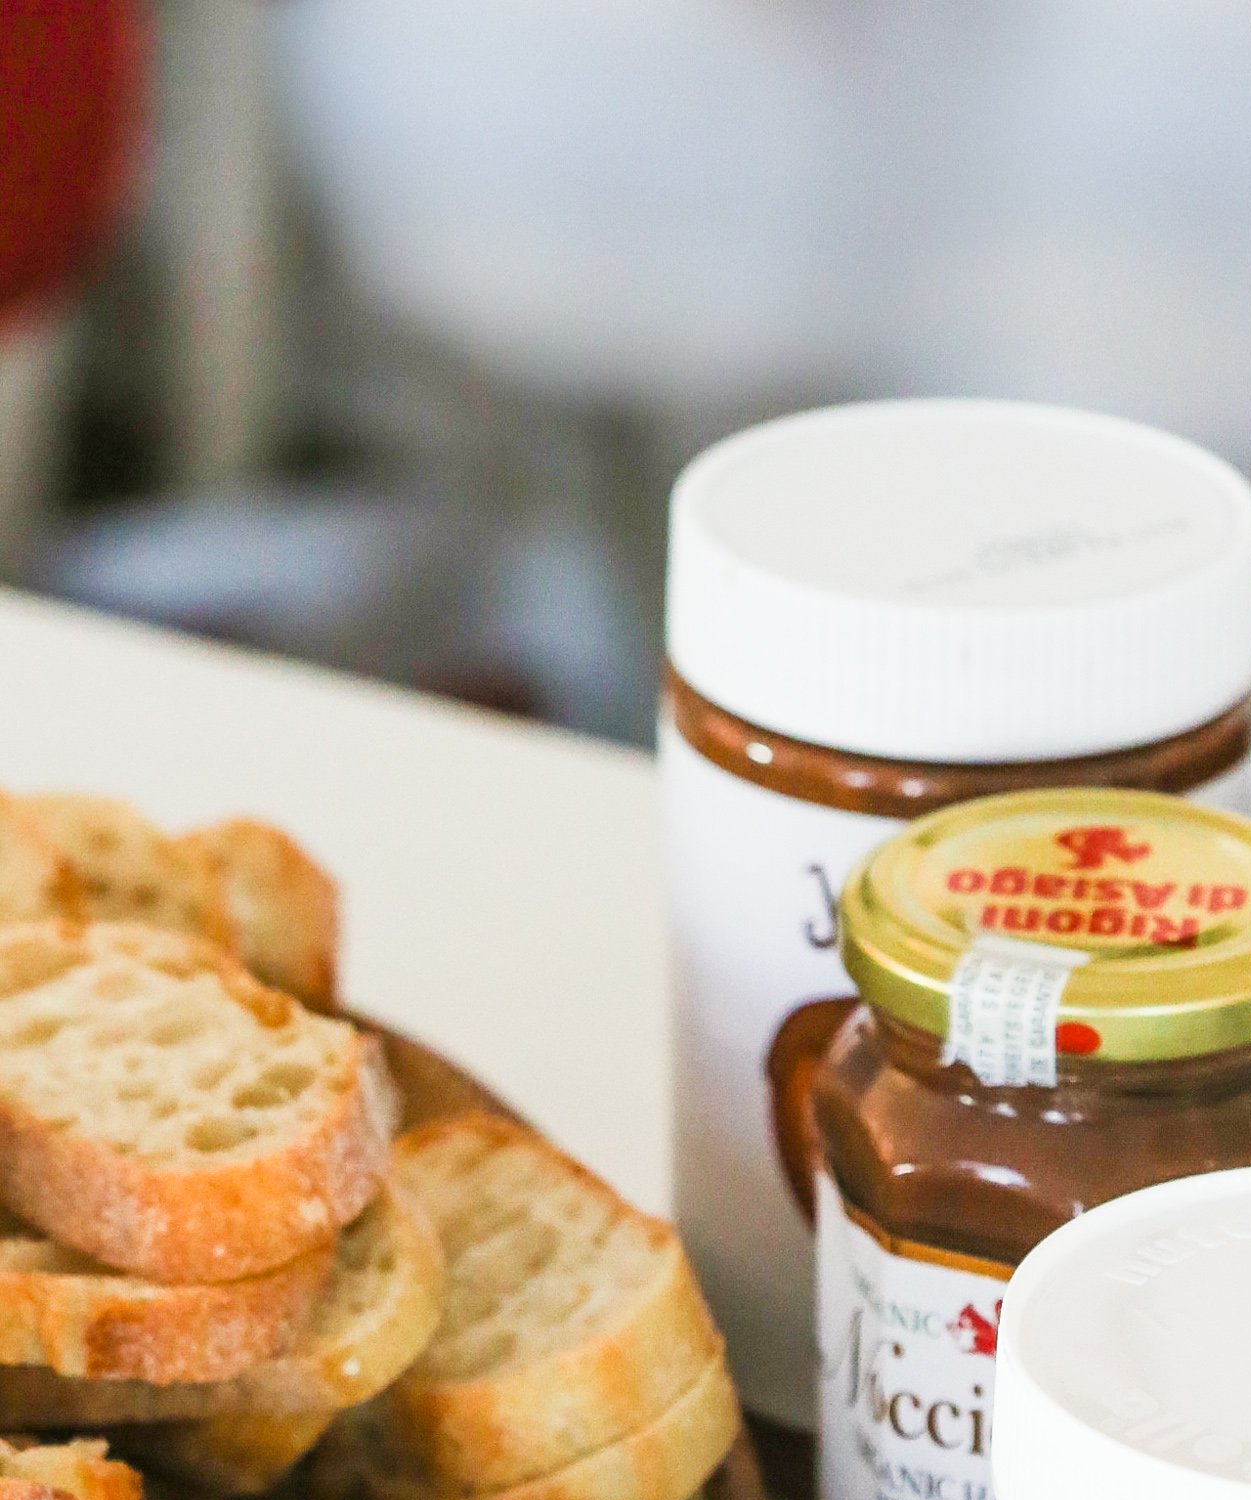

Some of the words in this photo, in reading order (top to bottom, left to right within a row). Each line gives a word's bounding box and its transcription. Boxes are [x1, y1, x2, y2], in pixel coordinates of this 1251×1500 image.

[945, 866, 1177, 910] Asiago
[1188, 883, 1249, 915] di
[980, 903, 1200, 950] Rigoni
